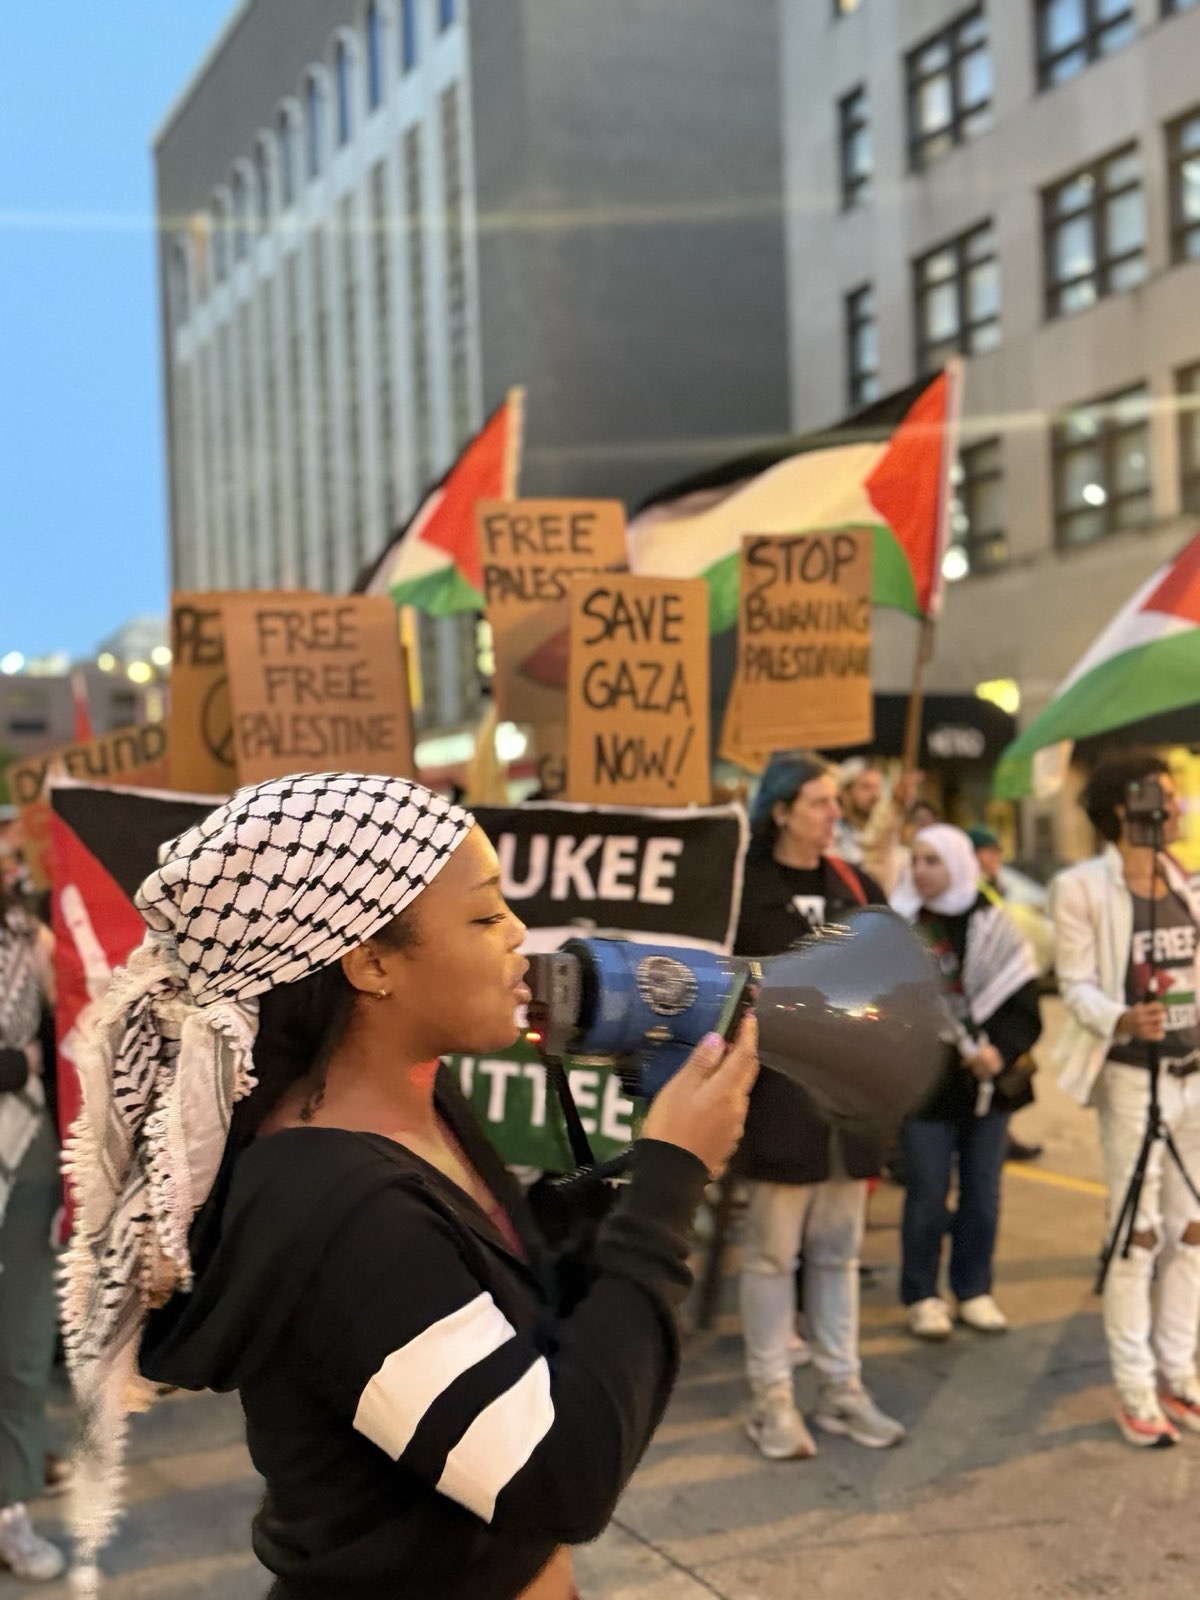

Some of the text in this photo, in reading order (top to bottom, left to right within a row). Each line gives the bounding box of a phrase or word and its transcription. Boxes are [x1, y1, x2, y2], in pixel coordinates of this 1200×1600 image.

[484, 512, 596, 554] FREE
[483, 562, 600, 603] PALES
[746, 533, 858, 589] STOP
[255, 606, 360, 655] FREE
[583, 589, 684, 645] SAVE
[264, 661, 373, 704] FREE
[583, 659, 693, 717] GAZA
[238, 712, 397, 761] PALESTINE
[594, 726, 694, 789] NOW!
[14, 723, 168, 804] DFUND
[497, 833, 684, 906] UKEE
[1132, 924, 1197, 965] FREE
